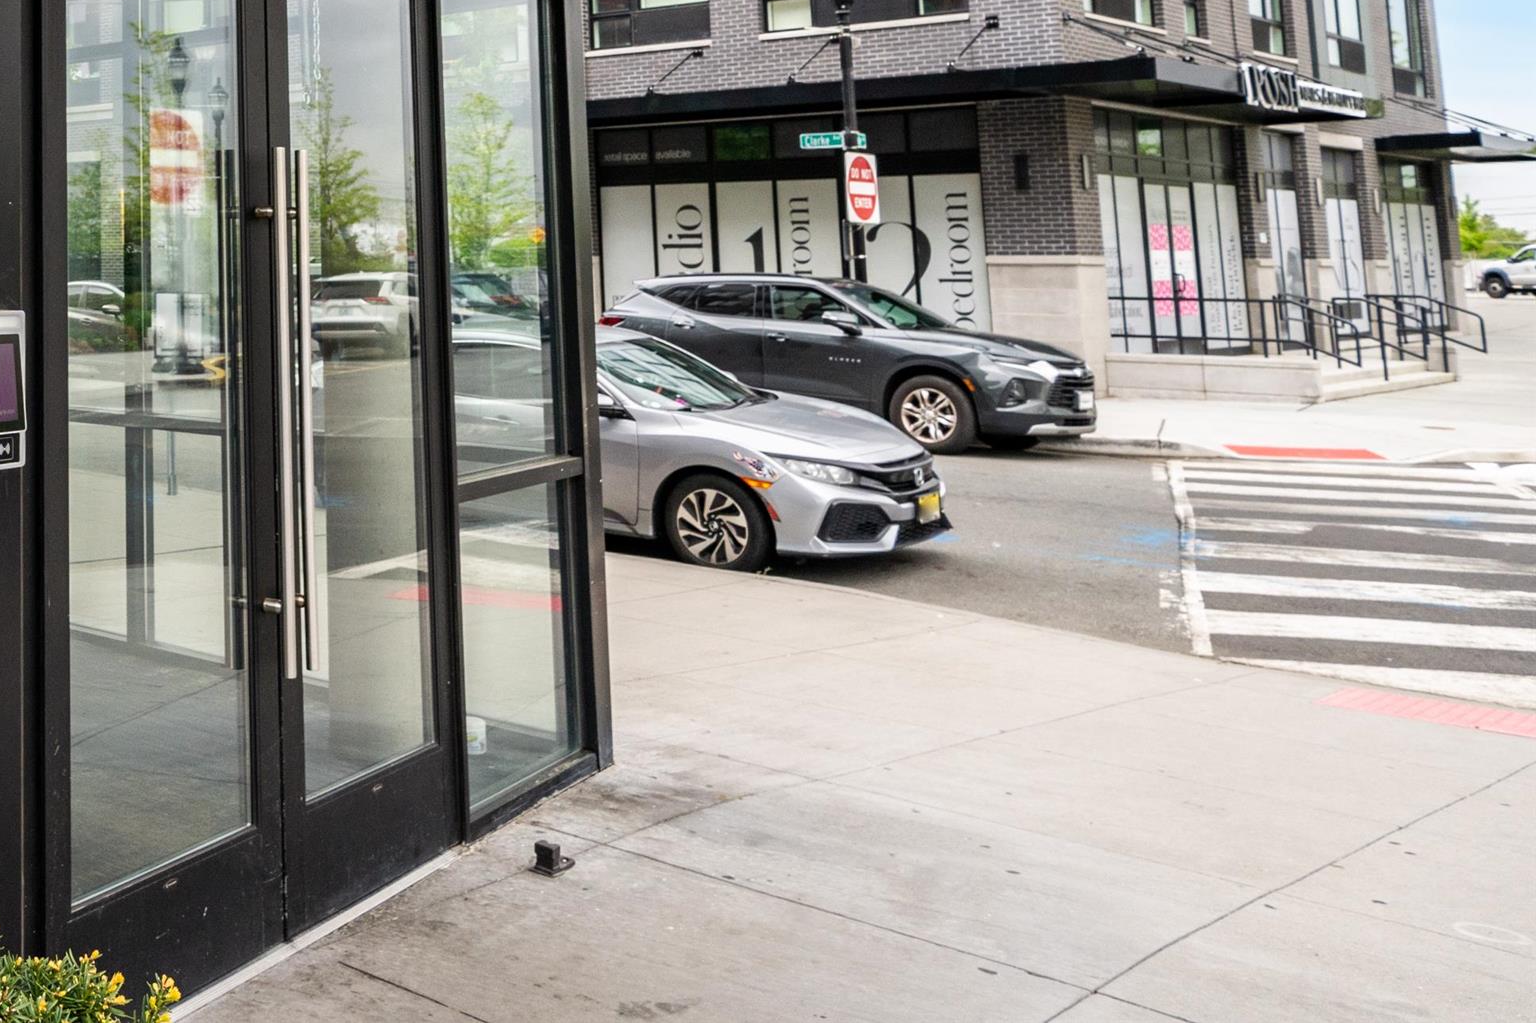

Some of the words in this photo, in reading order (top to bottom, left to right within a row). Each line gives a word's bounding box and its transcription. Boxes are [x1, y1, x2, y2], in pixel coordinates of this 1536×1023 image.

[804, 135, 830, 148] Clarke
[851, 167, 860, 179] DO
[861, 168, 872, 180] NOT
[853, 197, 873, 209] ENTER
